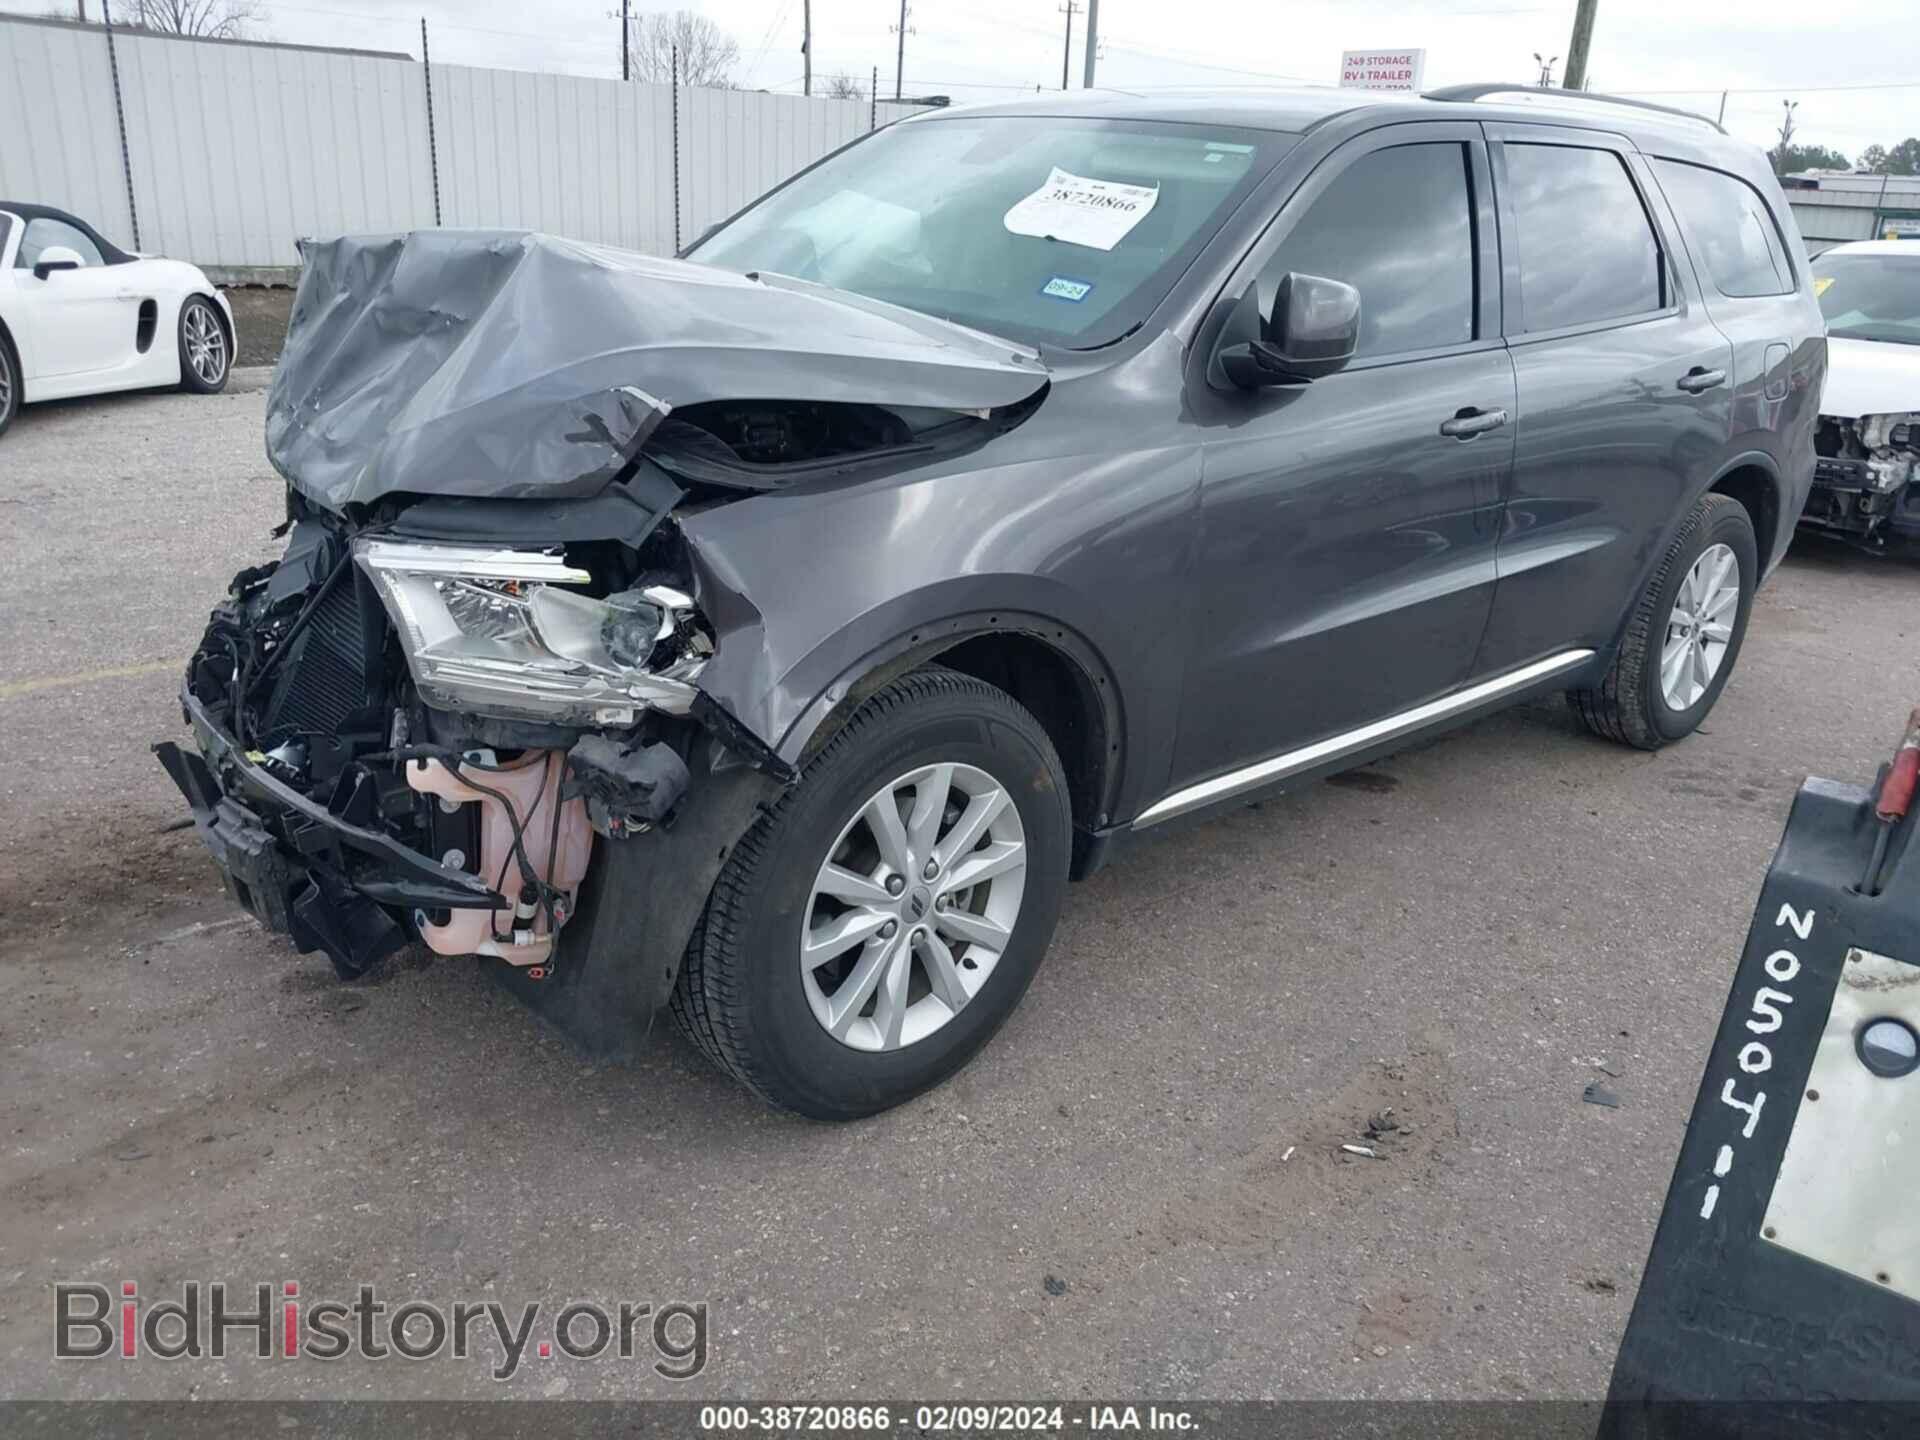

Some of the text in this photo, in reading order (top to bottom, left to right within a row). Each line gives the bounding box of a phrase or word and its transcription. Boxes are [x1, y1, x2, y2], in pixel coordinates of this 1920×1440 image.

[1347, 55, 1412, 66] 249 STORAGE
[1344, 71, 1359, 80] RV
[1367, 70, 1412, 80] TRAILER
[1046, 188, 1137, 212] 38720866
